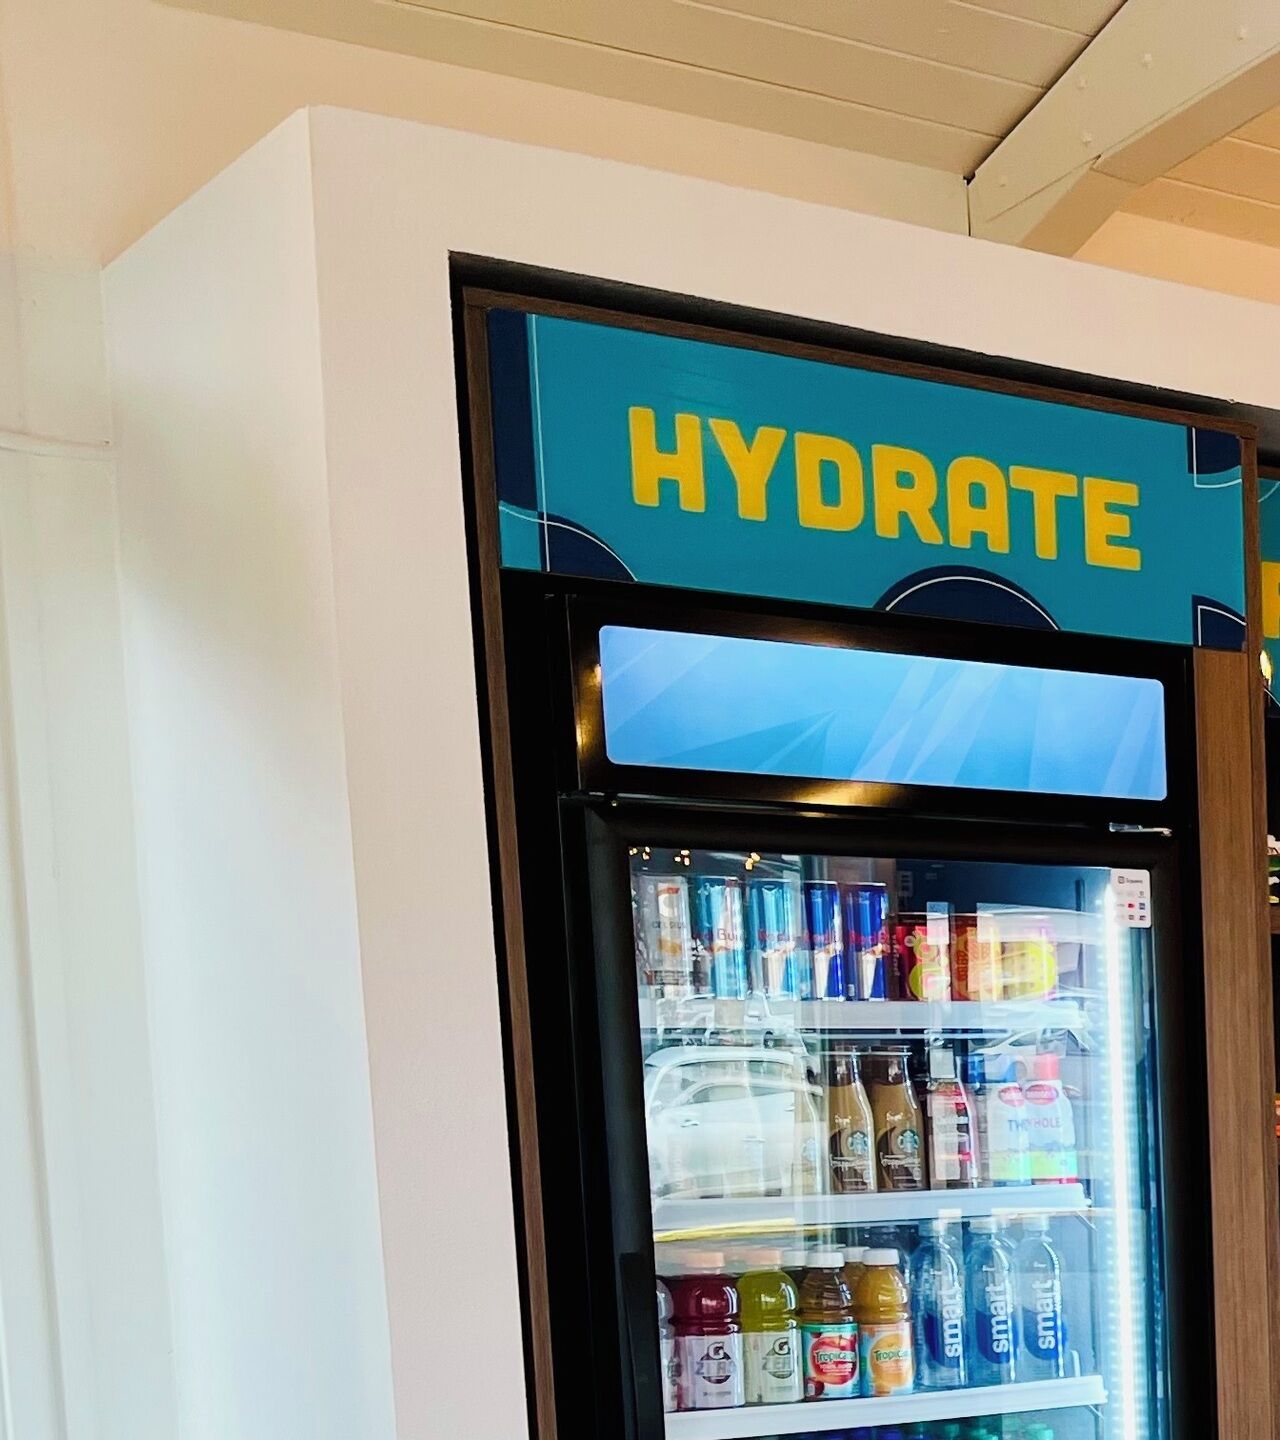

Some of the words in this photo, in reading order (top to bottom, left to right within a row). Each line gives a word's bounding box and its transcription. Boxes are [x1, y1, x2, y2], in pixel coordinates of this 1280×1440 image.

[628, 406, 1142, 571] HYDRATE
[941, 1285, 962, 1358] smart
[986, 1281, 1009, 1354] smart
[1032, 1279, 1056, 1351] smart
